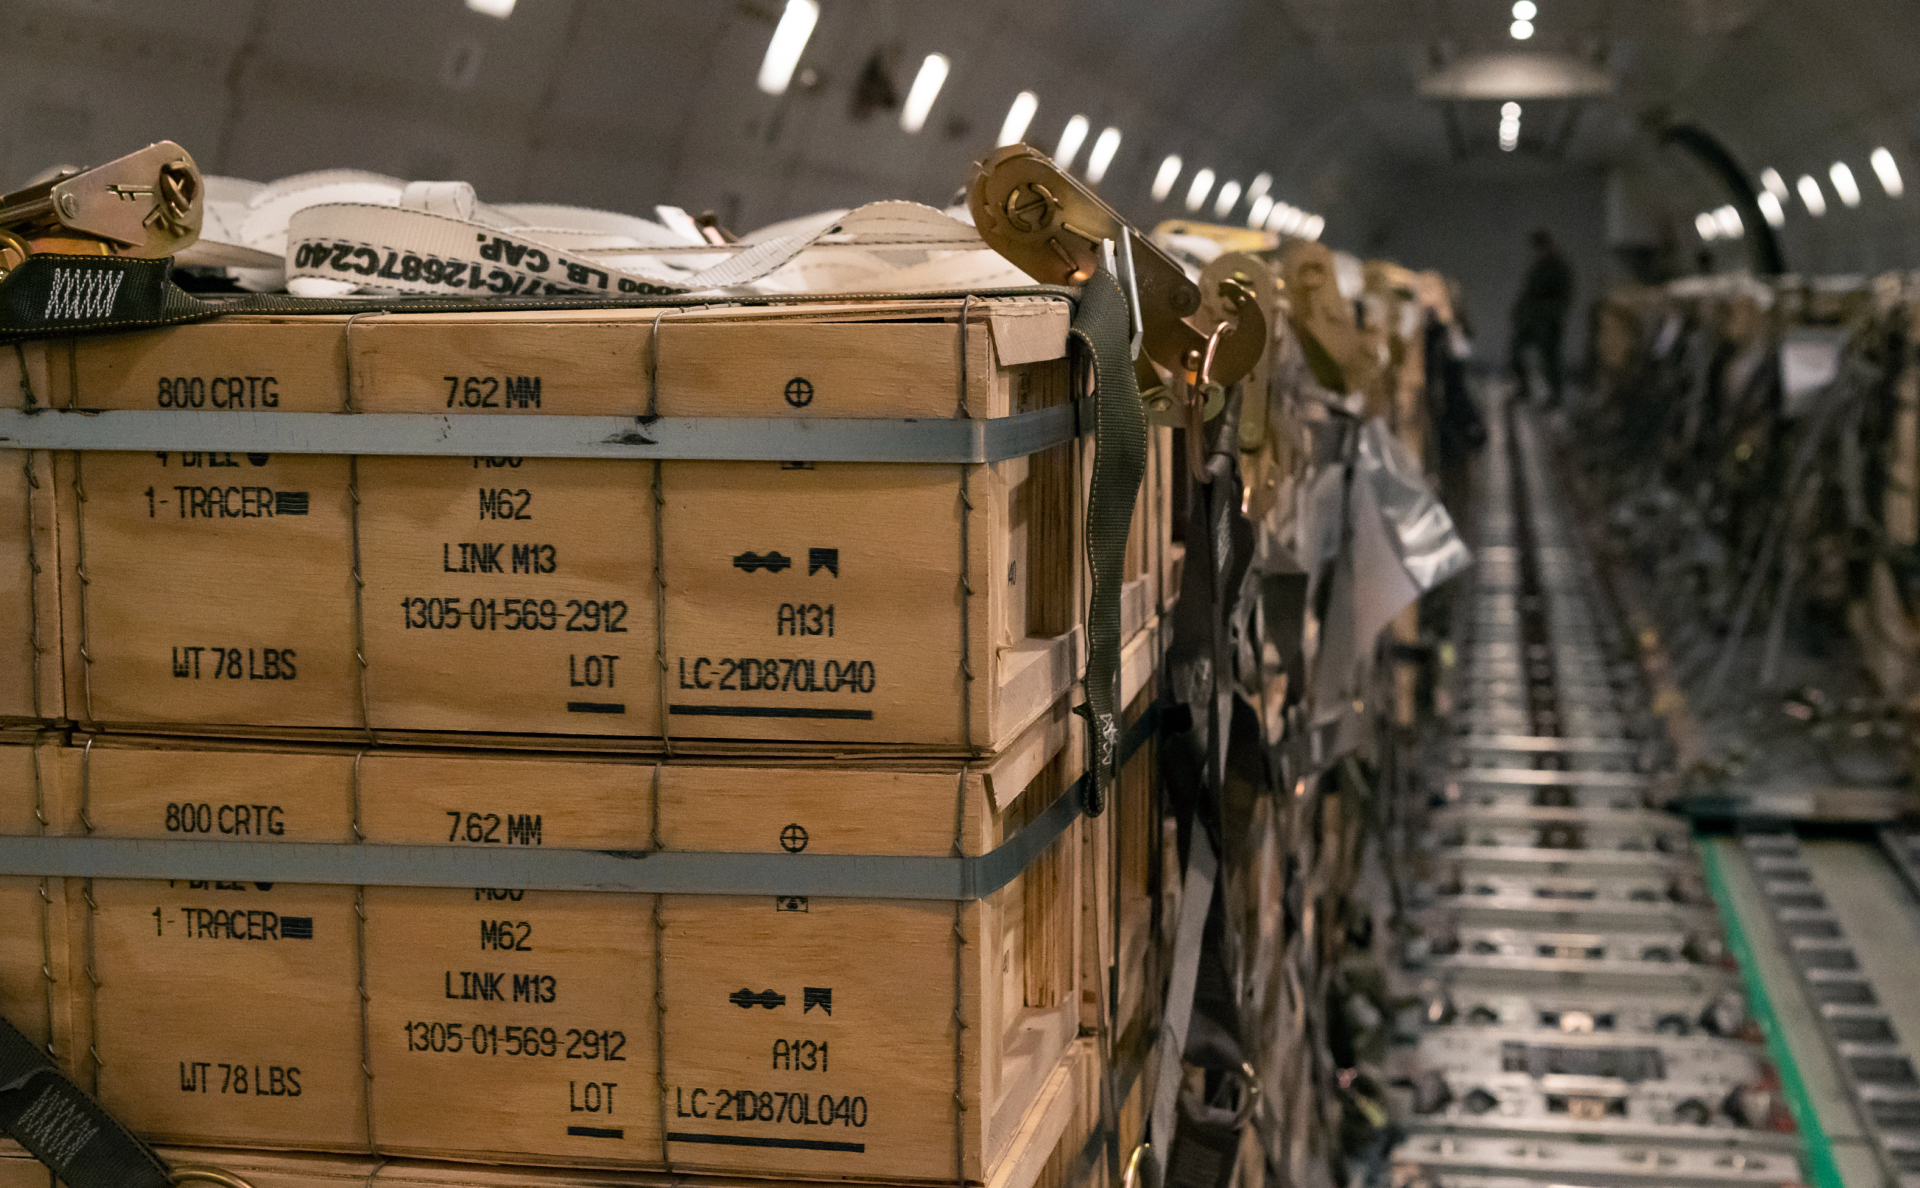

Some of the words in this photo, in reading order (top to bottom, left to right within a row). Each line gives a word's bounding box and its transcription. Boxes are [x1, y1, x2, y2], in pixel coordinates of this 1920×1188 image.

[476, 232, 550, 273] CAP.
[558, 257, 609, 289] LB.
[157, 377, 205, 408] 800
[211, 376, 279, 408] CRTG
[444, 376, 499, 408] 7.62
[506, 376, 541, 409] MM
[174, 486, 274, 518] TRACER
[479, 488, 532, 520] M62
[443, 543, 505, 573] LINK
[512, 544, 557, 574] M13
[401, 597, 628, 633] 1305-01-569-2912
[777, 603, 834, 637] A131
[172, 646, 205, 680] WT
[211, 647, 242, 680] 78
[249, 647, 297, 680] LBS
[569, 654, 620, 688] LOT
[166, 803, 212, 834] 800
[218, 804, 285, 836] CRTG
[447, 811, 501, 844] 7.62
[507, 813, 542, 846] MM
[181, 907, 279, 941] TRACER
[480, 919, 532, 952] M62
[445, 970, 506, 1002] LINK
[513, 973, 557, 1003] M13
[404, 1020, 627, 1062] 1305-01-569-2912
[773, 1038, 828, 1073] A131
[180, 1061, 211, 1094] WT
[218, 1063, 249, 1094] 78
[255, 1065, 302, 1097] LBS
[570, 1080, 618, 1115] LOT
